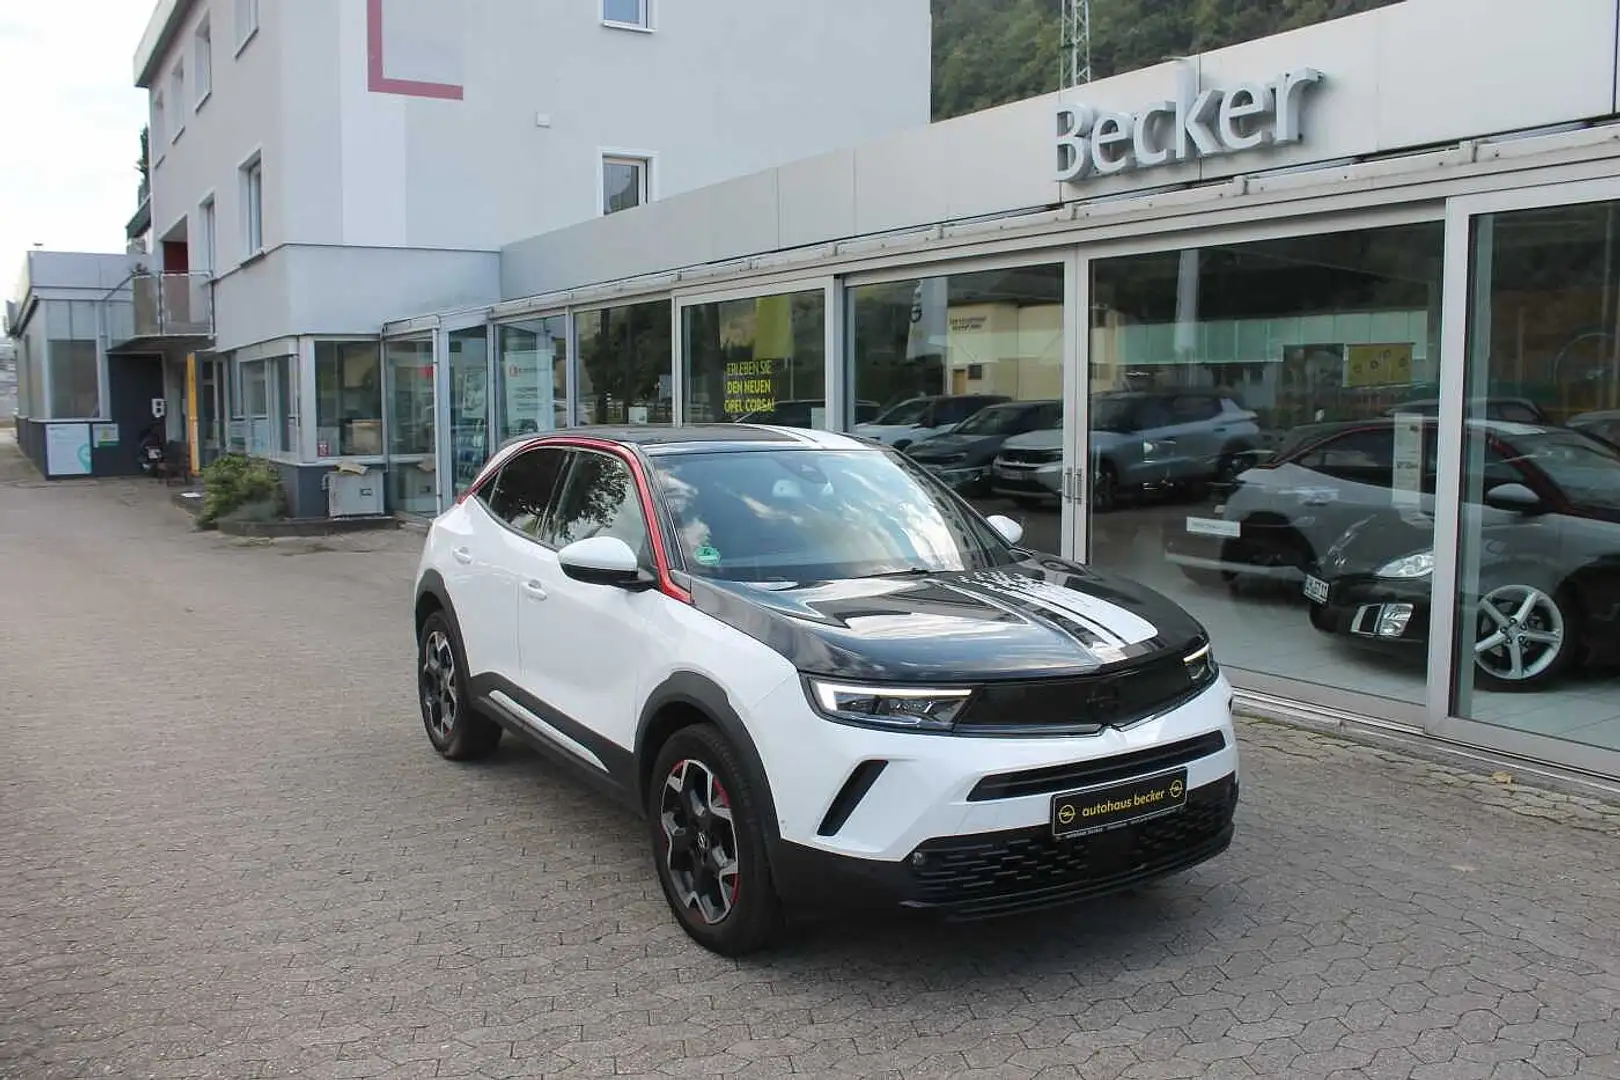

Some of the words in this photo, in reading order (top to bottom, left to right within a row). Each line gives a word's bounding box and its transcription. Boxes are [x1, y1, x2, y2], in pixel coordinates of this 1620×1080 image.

[1056, 66, 1325, 181] Becker
[726, 361, 759, 376] ERLEBEN
[760, 360, 773, 374] SIE
[727, 380, 743, 394] DEN
[744, 379, 771, 394] NEUEN
[724, 399, 744, 413] OPEL
[1082, 800, 1132, 817] autohaus
[1133, 789, 1166, 806] becker
